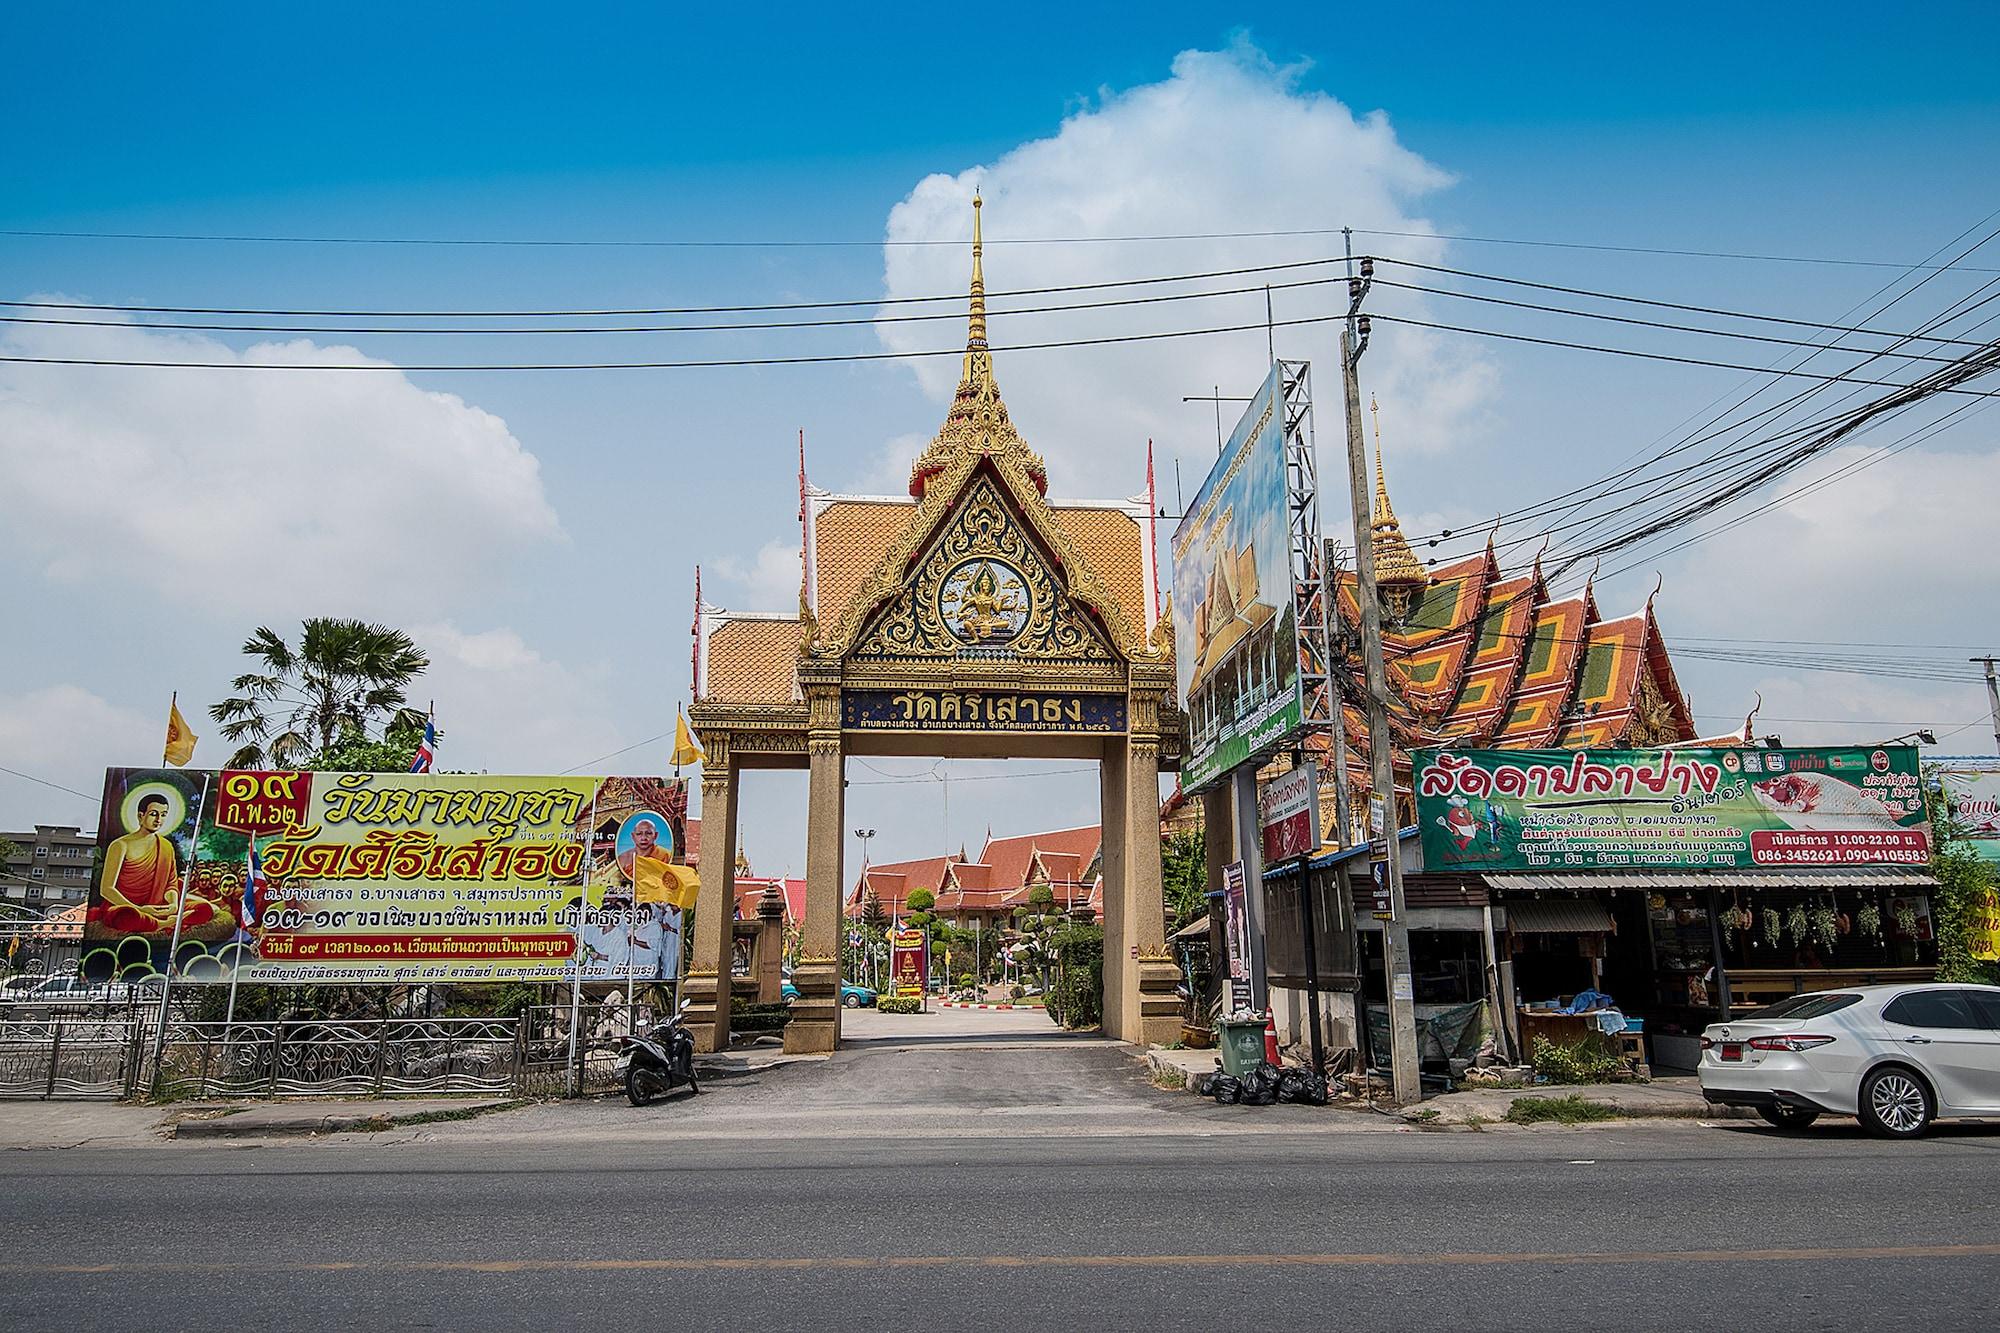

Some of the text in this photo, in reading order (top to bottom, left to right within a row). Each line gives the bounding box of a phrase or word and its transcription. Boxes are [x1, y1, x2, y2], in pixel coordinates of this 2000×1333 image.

[892, 691, 1081, 721] วัดศิริเสาธง
[989, 720, 1065, 731] จังหวัดสมุทรปราการ
[226, 773, 299, 801] ๑๙
[1421, 751, 1720, 799] ลัดดาปลาย่าง
[323, 774, 584, 838] วันมาฆบูชา
[1670, 780, 1746, 813] อินเตอร์
[261, 823, 583, 880] วัดศิริเสาธง
[1771, 833, 1917, 846] เปิดบริการ 10.00-22.00 น.
[1634, 853, 1680, 863] มากกว่า
[1687, 854, 1708, 863] 100
[1713, 854, 1735, 865] เมนู
[360, 888, 445, 900] อ.บางเสาธง
[453, 886, 563, 905] จ.สมุทรปราการ
[266, 935, 294, 954] วันที่
[408, 937, 568, 956] เวียนเทียนถวายเป็นพุทธบูชา
[250, 965, 390, 981] ขอเชิญปฏิบัติธรรมทุกวัน
[394, 965, 419, 982] ศุกร์
[422, 964, 448, 977] เสาร์
[450, 964, 493, 977] อาทิตย์
